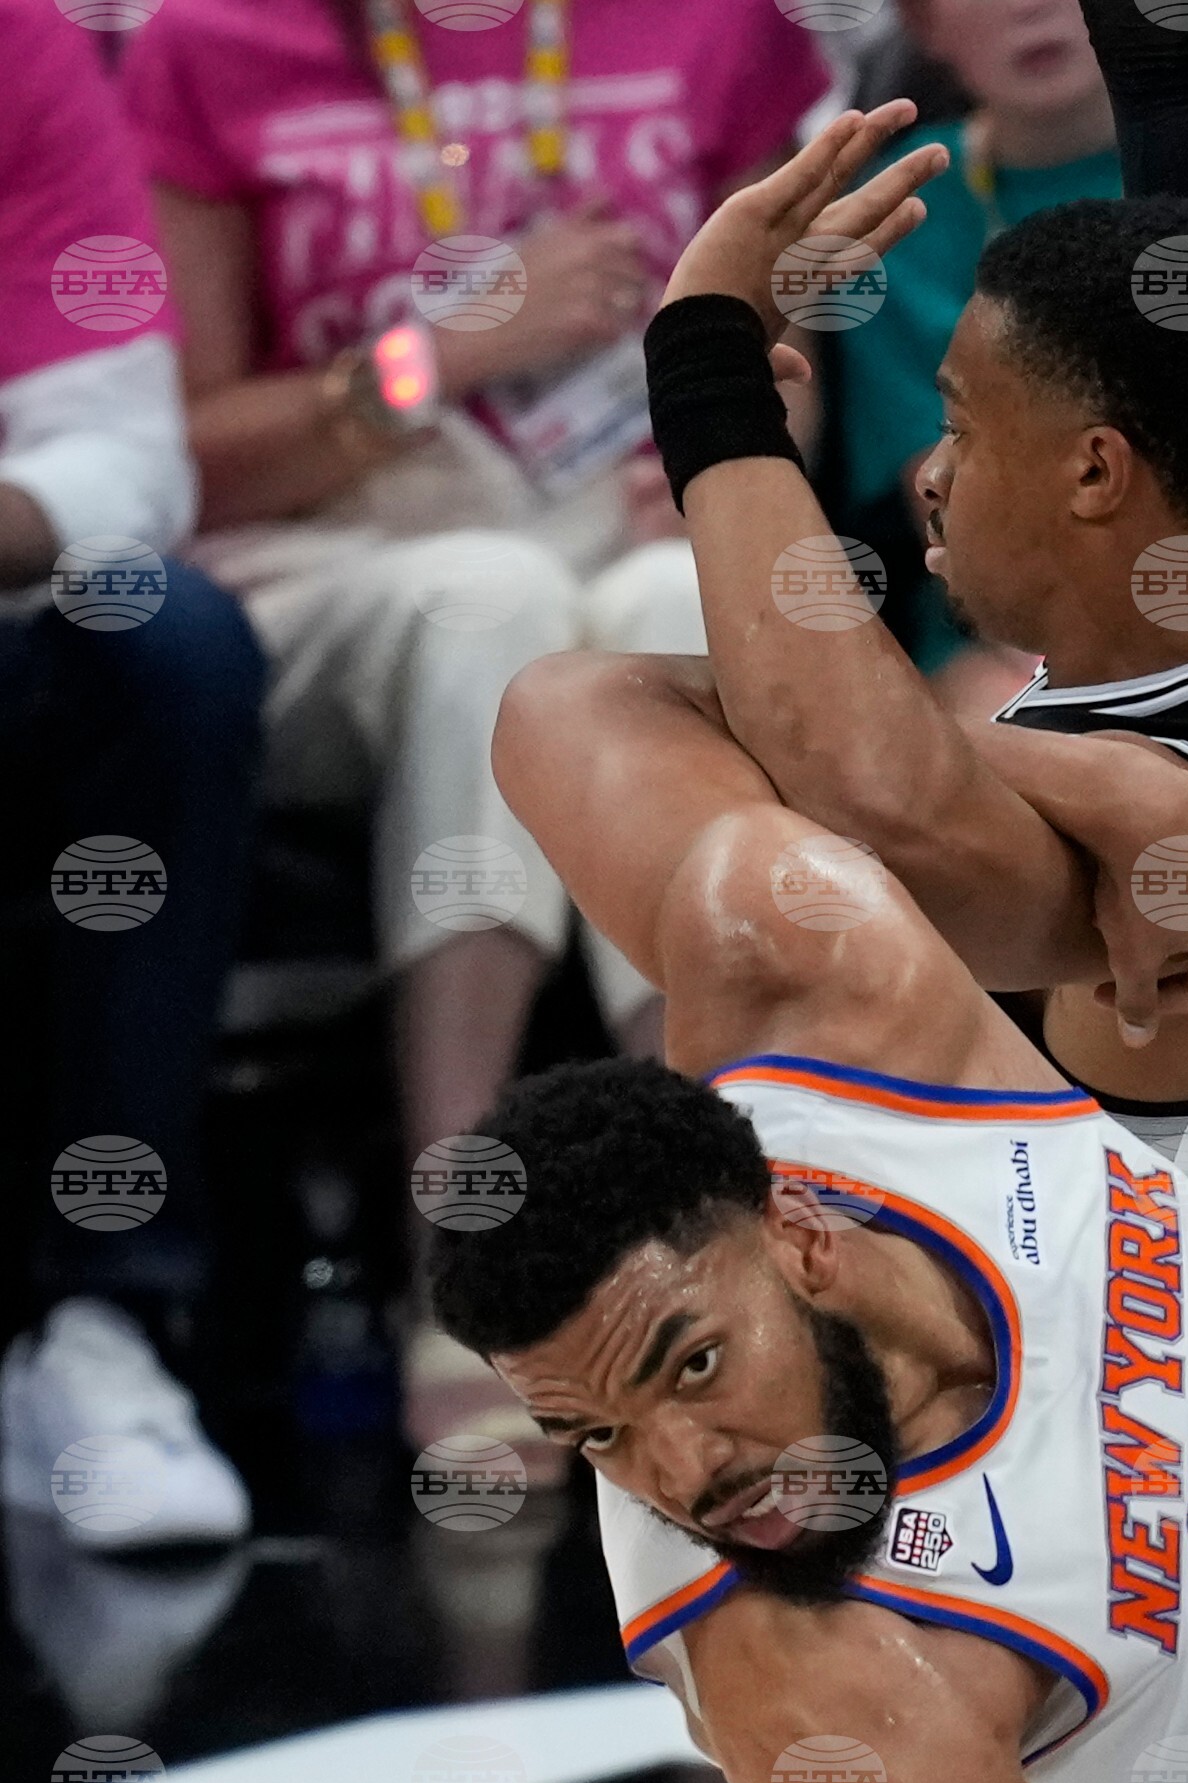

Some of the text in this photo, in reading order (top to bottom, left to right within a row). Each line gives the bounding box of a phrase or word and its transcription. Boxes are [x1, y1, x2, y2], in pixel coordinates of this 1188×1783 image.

[1019, 1218, 1040, 1265] abu
[1098, 1146, 1185, 1659] NEW YORK
[895, 1512, 918, 1561] USA
[920, 1513, 946, 1569] 250
